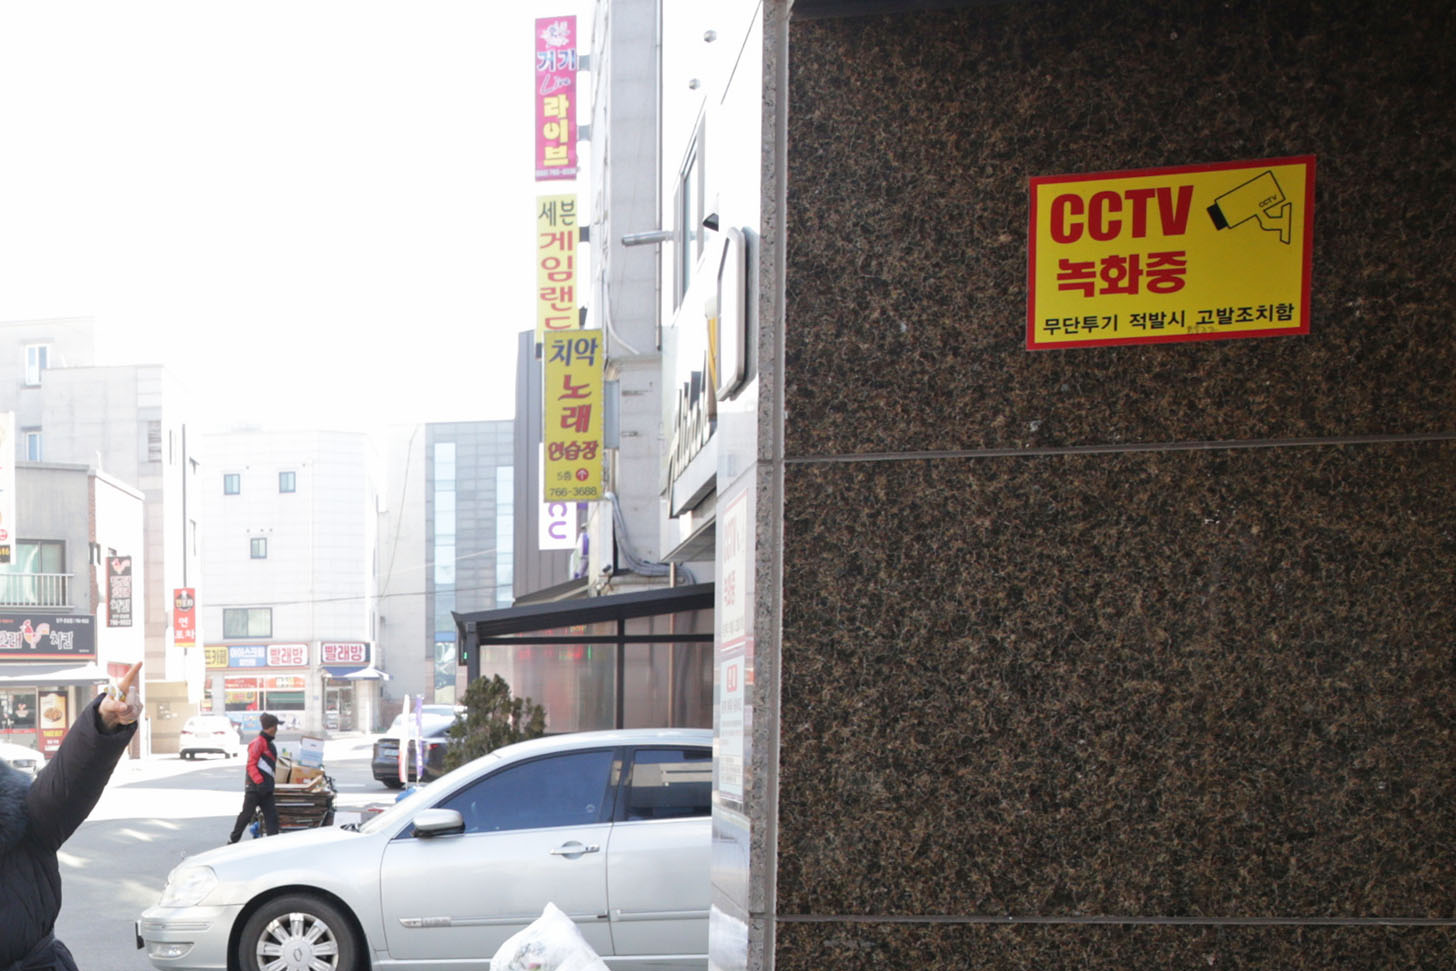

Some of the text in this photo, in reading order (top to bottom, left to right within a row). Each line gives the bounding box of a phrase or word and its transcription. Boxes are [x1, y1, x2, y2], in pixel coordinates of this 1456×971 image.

[543, 94, 570, 167] 라이브
[538, 199, 577, 227] 세븐
[1050, 185, 1194, 244] CCTV
[1056, 251, 1188, 298] 녹화중
[1043, 303, 1296, 336] 무단투기 적발시 고발조치함
[549, 337, 599, 367] 치악
[558, 373, 592, 433] 노래
[548, 440, 599, 462] 연습장
[270, 647, 303, 665] 빨래방
[325, 645, 363, 662] 빨래방
